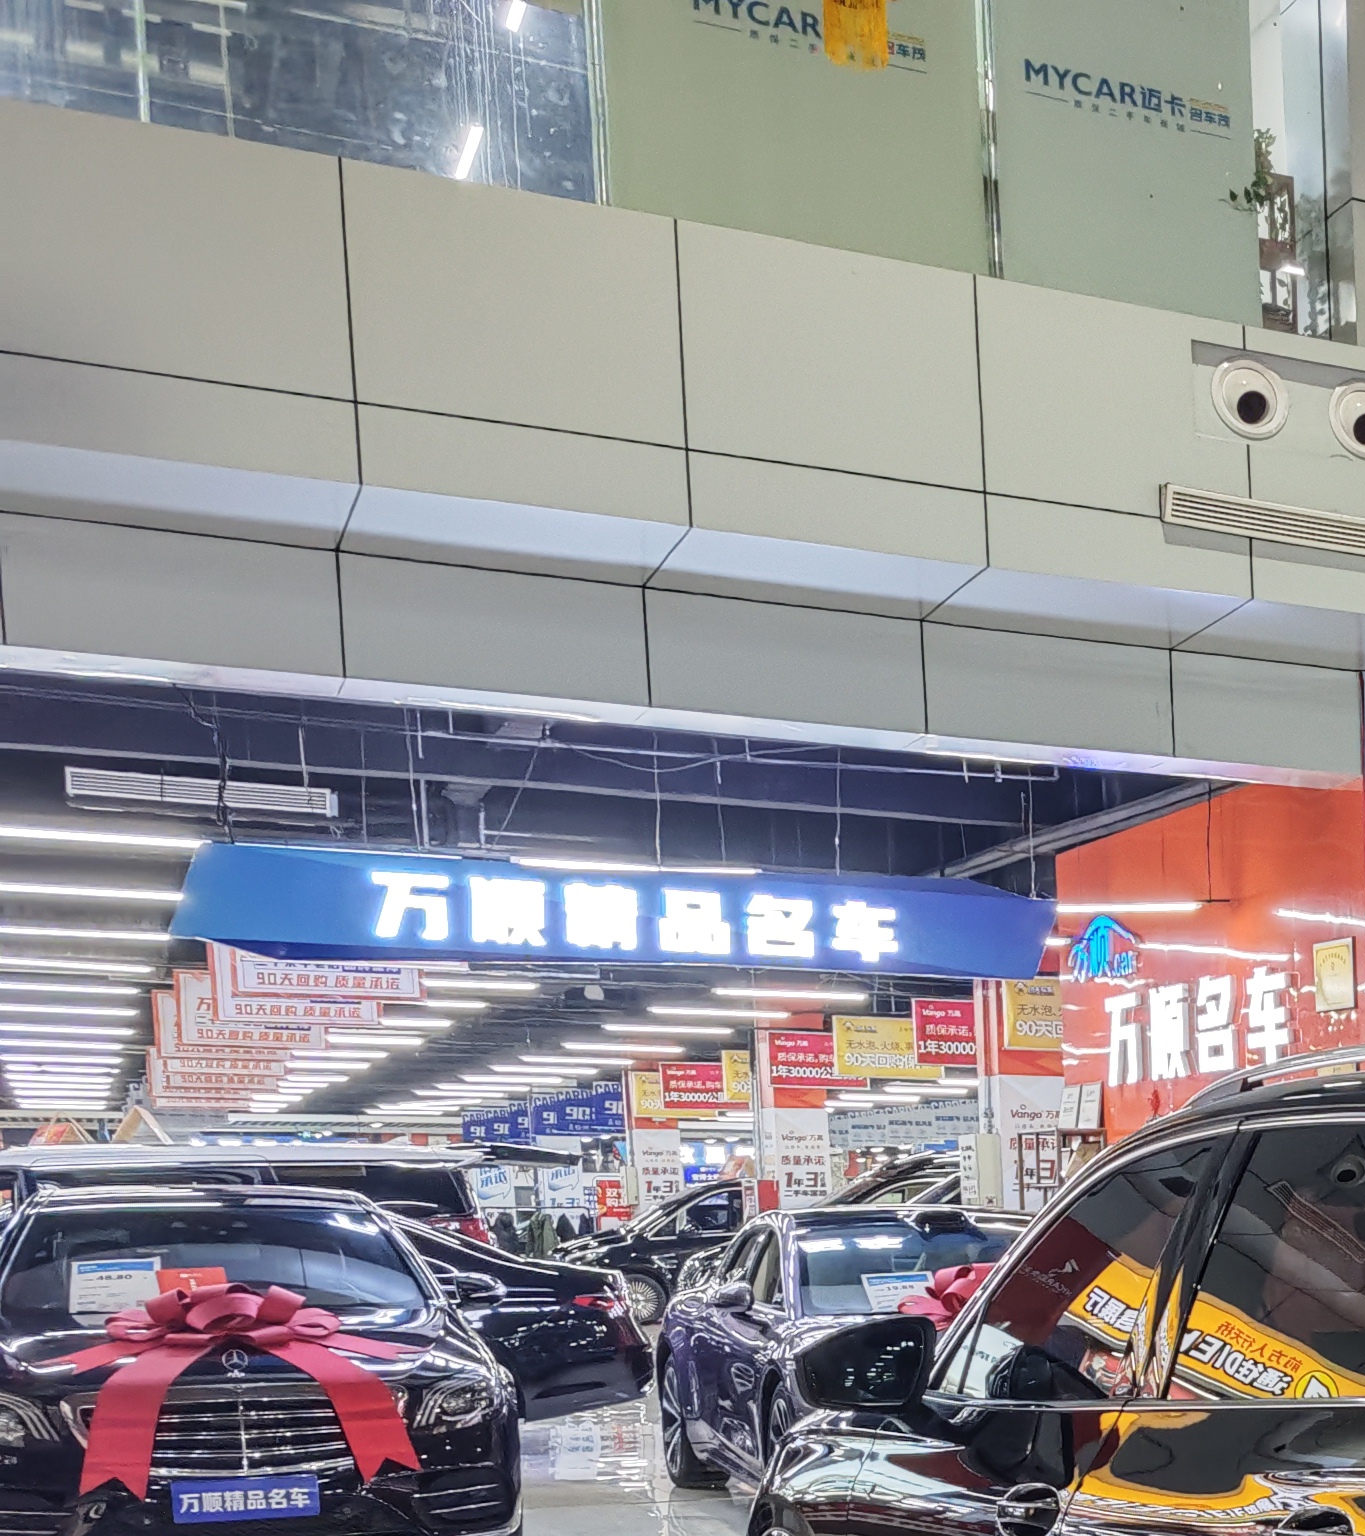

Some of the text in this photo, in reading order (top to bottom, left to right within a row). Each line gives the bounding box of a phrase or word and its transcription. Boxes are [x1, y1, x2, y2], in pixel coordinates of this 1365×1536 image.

[370, 869, 899, 962] 万顺精品名车
[256, 971, 400, 989] 90天回购 质量承诺
[1104, 965, 1291, 1087] 万顺名车
[179, 1487, 311, 1514] 万顺精品名车
